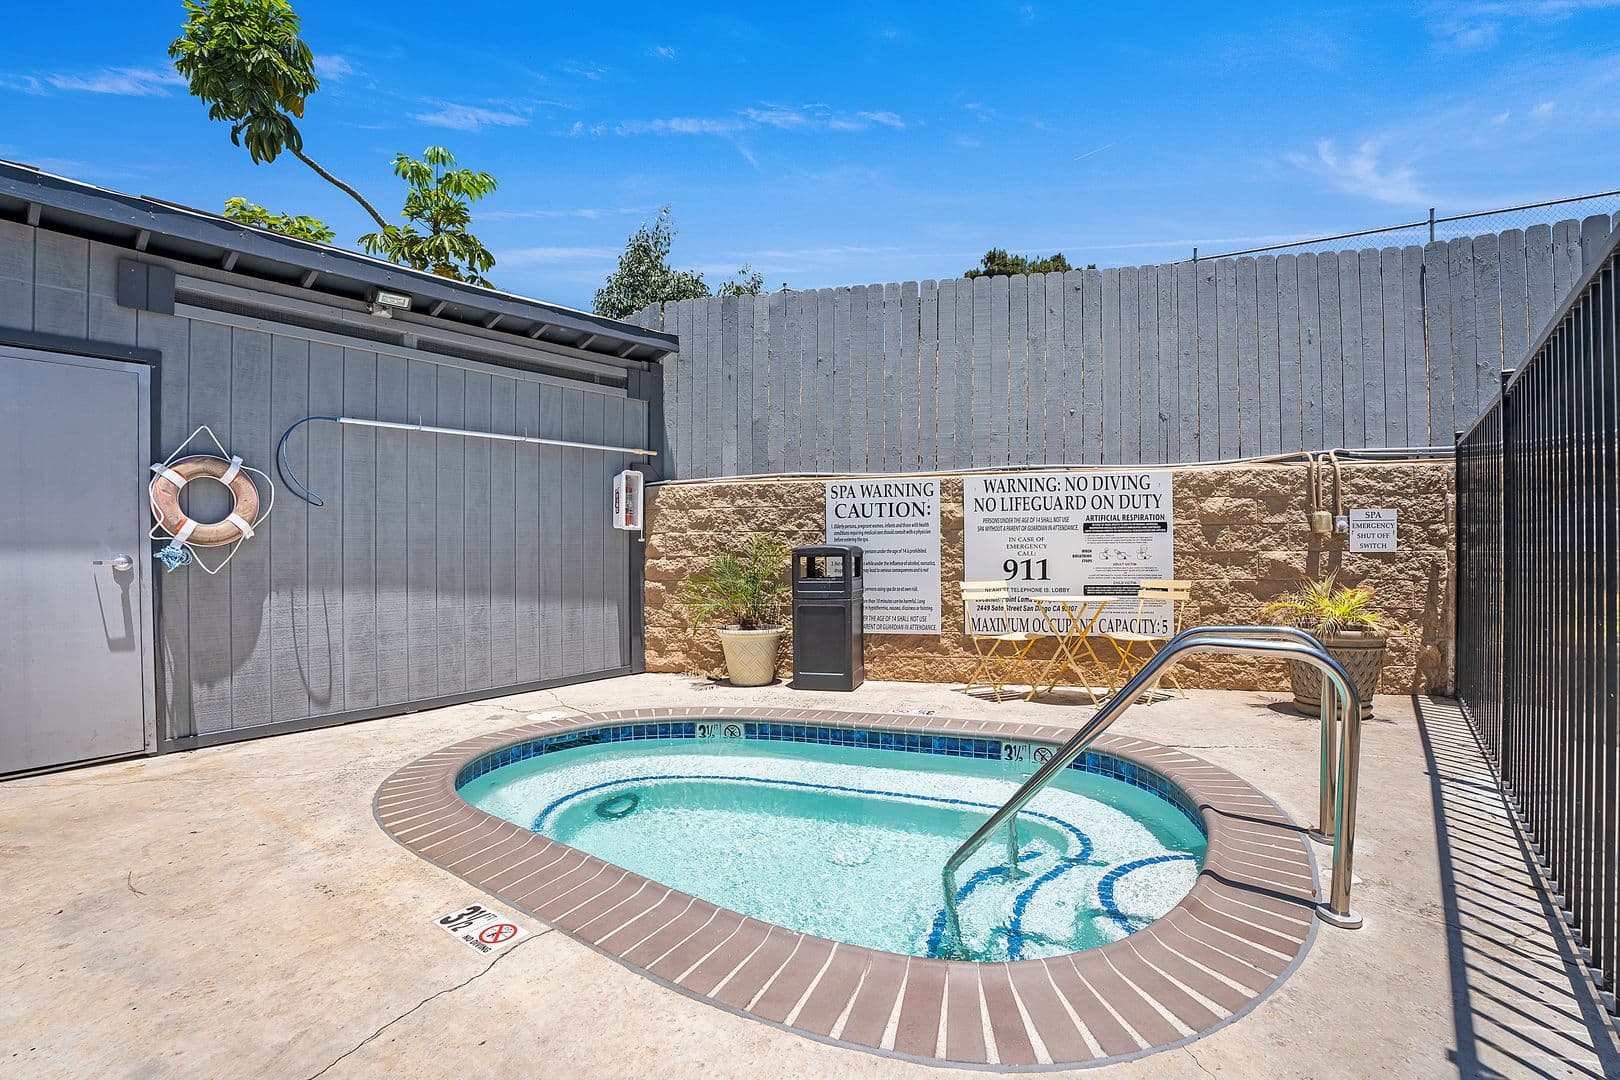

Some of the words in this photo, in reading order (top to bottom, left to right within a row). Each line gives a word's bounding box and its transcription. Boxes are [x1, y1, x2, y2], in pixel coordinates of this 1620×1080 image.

[830, 485, 857, 499] SPA
[860, 482, 935, 498] WARNING
[983, 476, 1061, 493] WARNING:
[1064, 476, 1088, 491] NO
[1092, 474, 1151, 490] DIVING
[835, 501, 931, 519] CAUTION:
[973, 497, 997, 512] NO
[1000, 495, 1086, 512] LIFEGUARD
[1091, 494, 1114, 510] ON
[1118, 493, 1163, 509] DUTY
[1121, 513, 1166, 521] RESPIRATION
[1365, 511, 1382, 519] SPA
[1003, 558, 1051, 581] 911
[971, 617, 1029, 632] MAXIMUM
[461, 934, 475, 942] NO
[469, 939, 492, 953] DIVING
